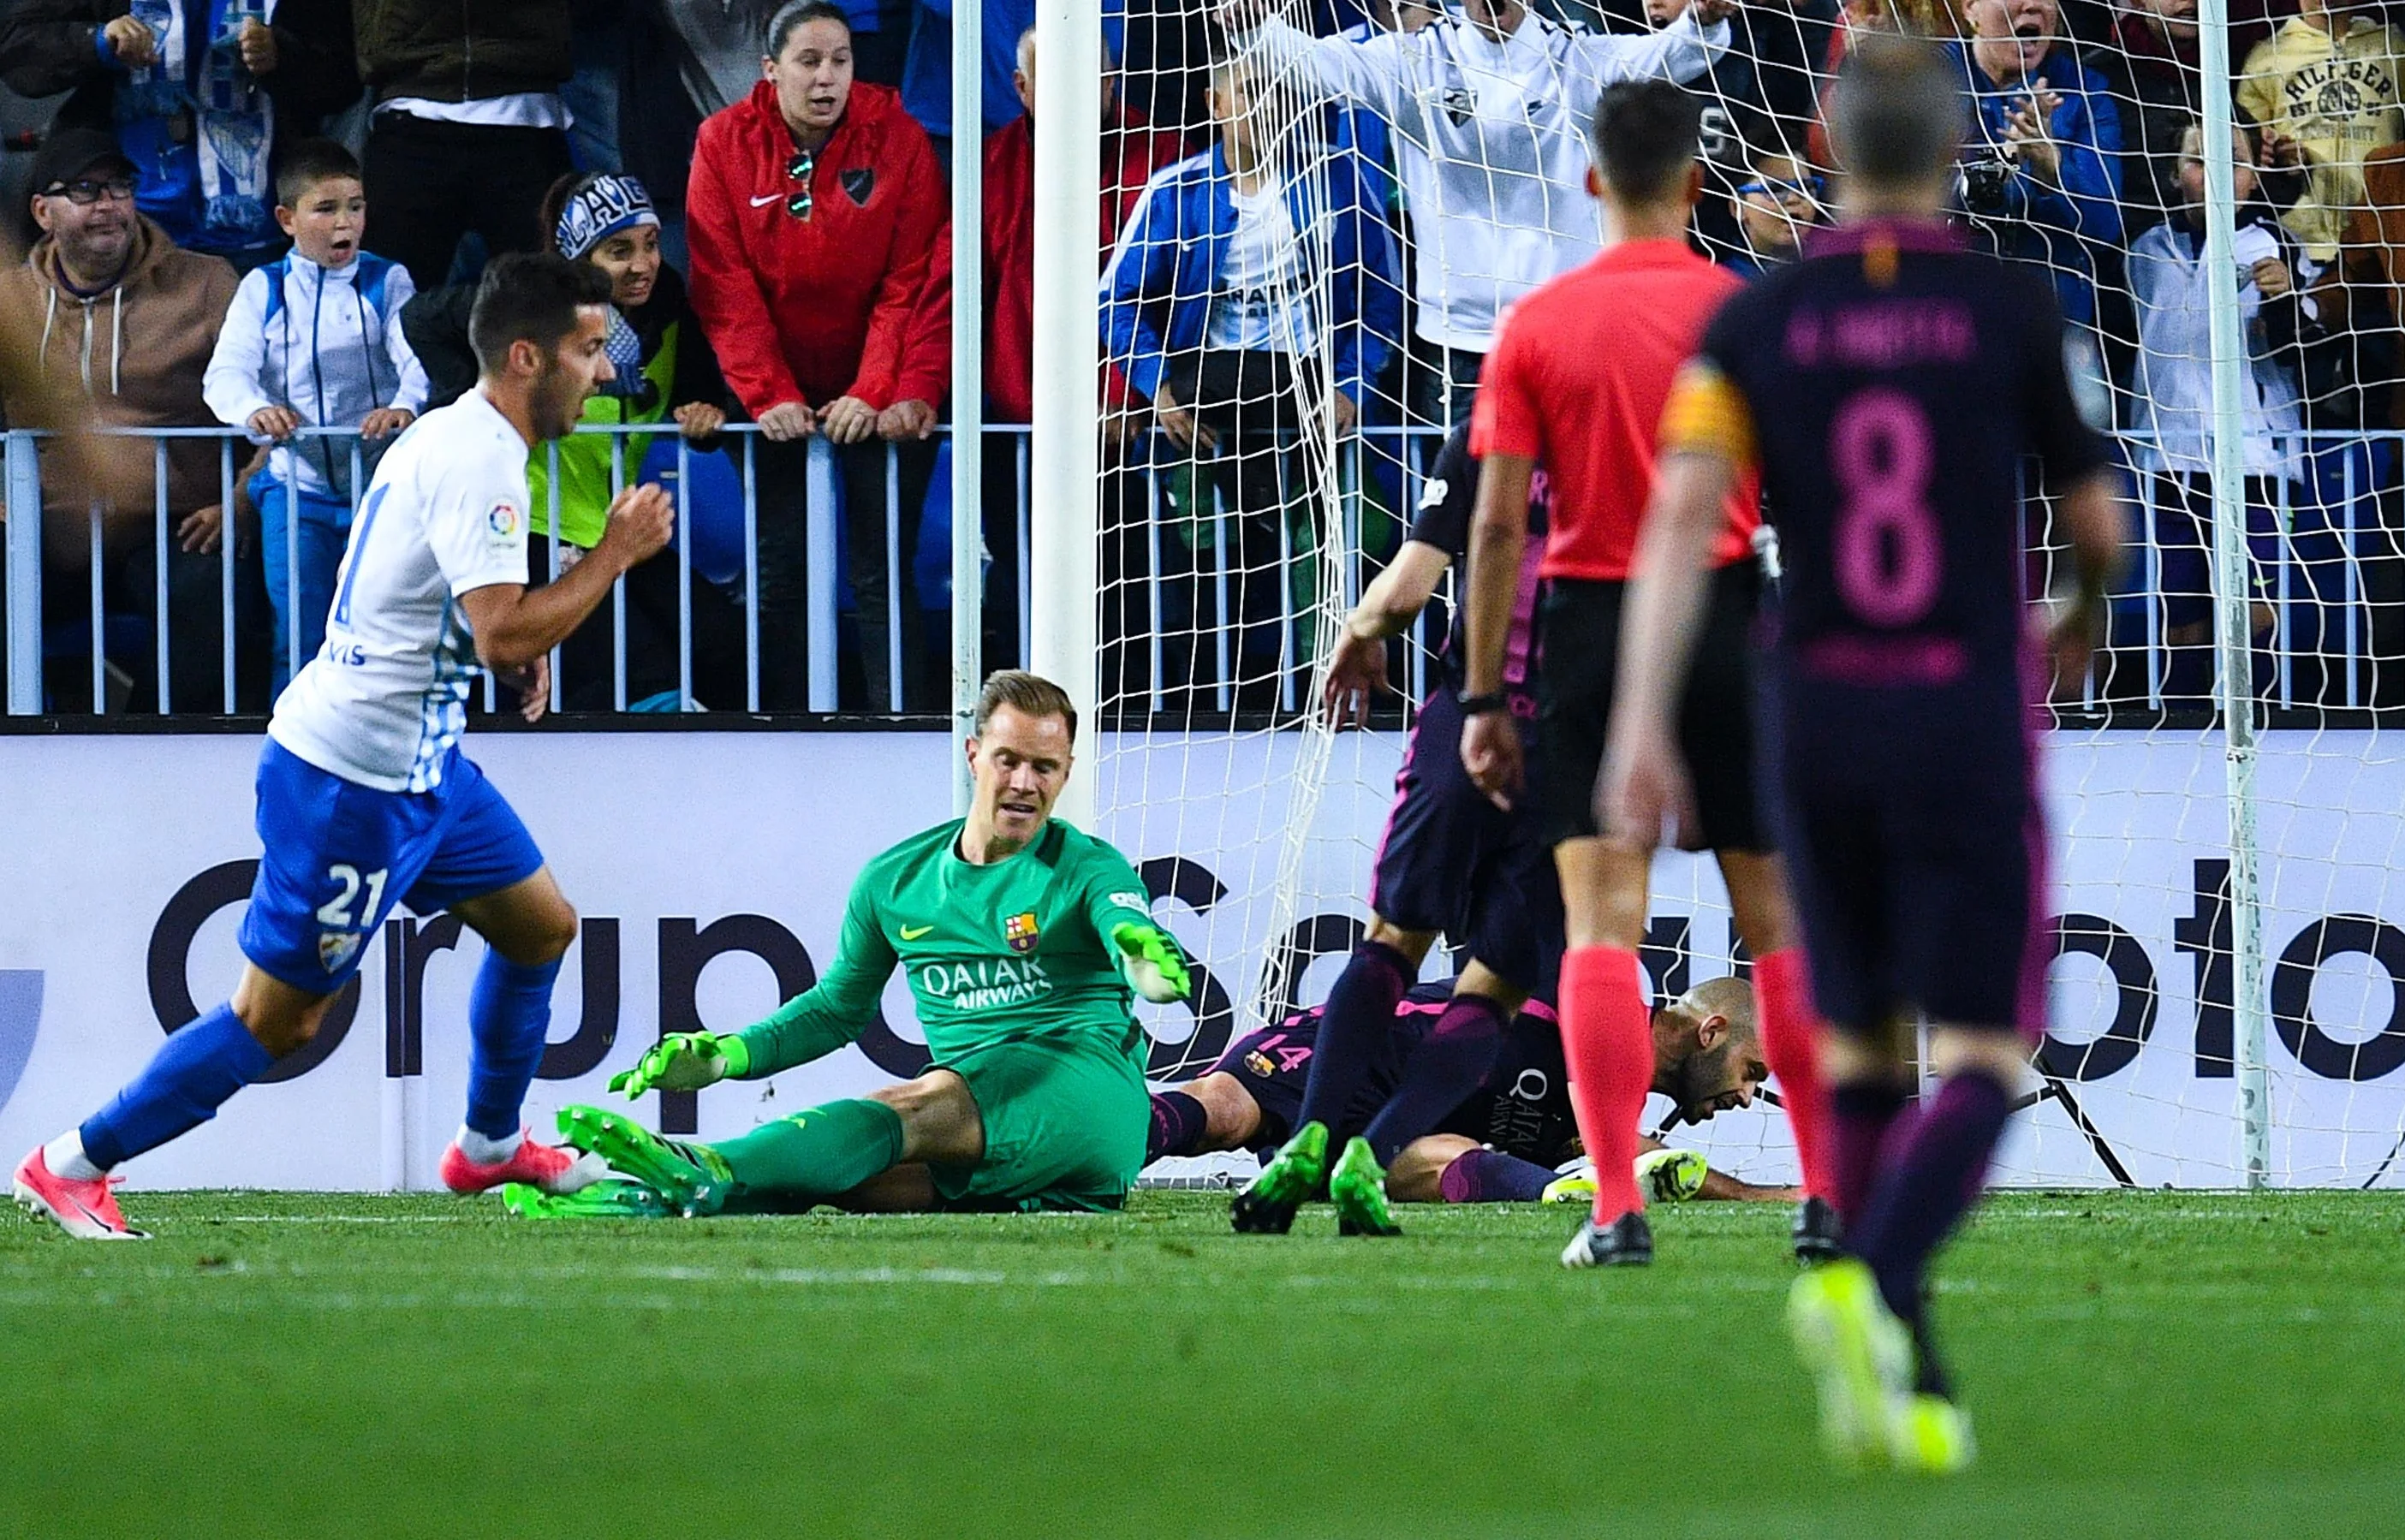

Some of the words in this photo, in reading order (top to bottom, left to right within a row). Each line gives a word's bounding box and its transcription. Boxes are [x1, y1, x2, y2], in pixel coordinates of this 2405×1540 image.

[2285, 57, 2392, 101] HILFGER
[1828, 385, 1944, 629] 8
[317, 864, 388, 927] 21
[955, 979, 1052, 1010] AIRWAYS
[1257, 1033, 1313, 1073] 14
